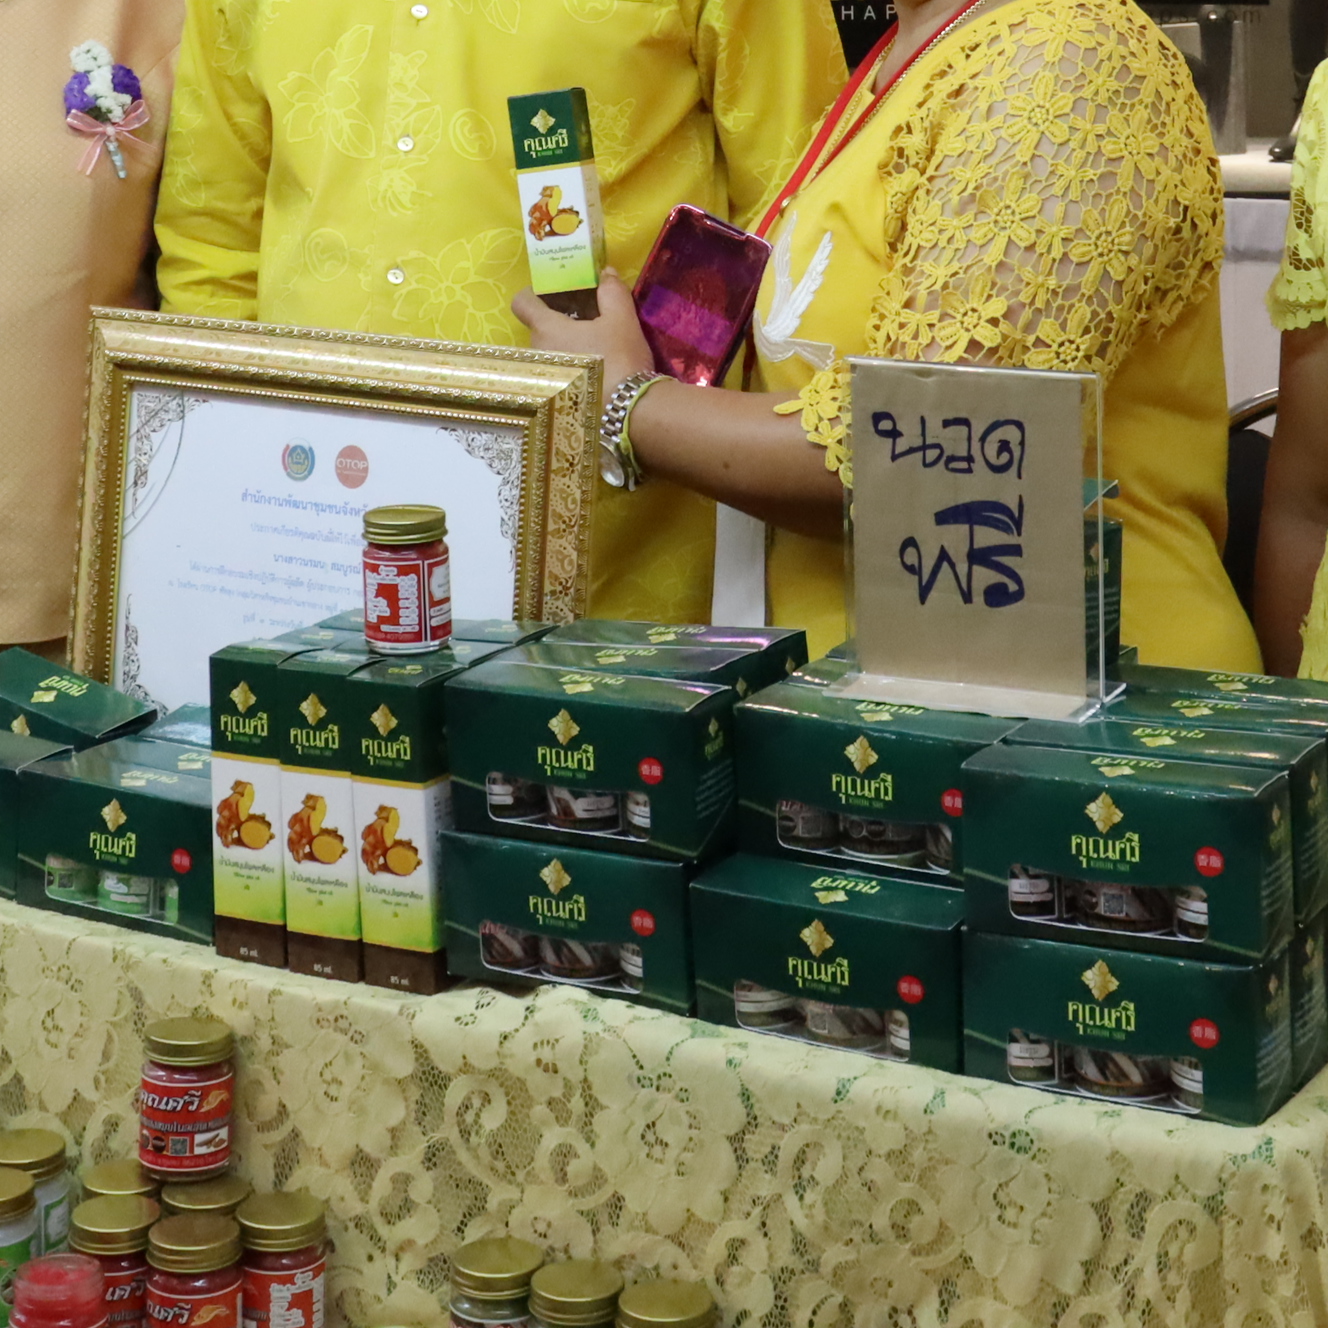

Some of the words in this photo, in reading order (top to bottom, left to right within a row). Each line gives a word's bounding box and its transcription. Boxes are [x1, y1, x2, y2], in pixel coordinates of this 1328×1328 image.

[336, 457, 368, 470] OTOP
[241, 488, 370, 518] สำนักงานพัฒนาชุมชนจังหวั
[220, 711, 268, 742] คุณศรี
[290, 723, 340, 755] คุณศรี
[361, 734, 412, 766] คุณศรี
[537, 743, 595, 776] คุณศรี
[831, 772, 893, 805] คุณศรี
[89, 831, 137, 860] คุณศรี
[1071, 831, 1141, 868] คุณศรี
[528, 893, 586, 926] คุณศรี
[788, 956, 849, 988] คุณศรี
[1067, 1000, 1136, 1035] คุณศรี
